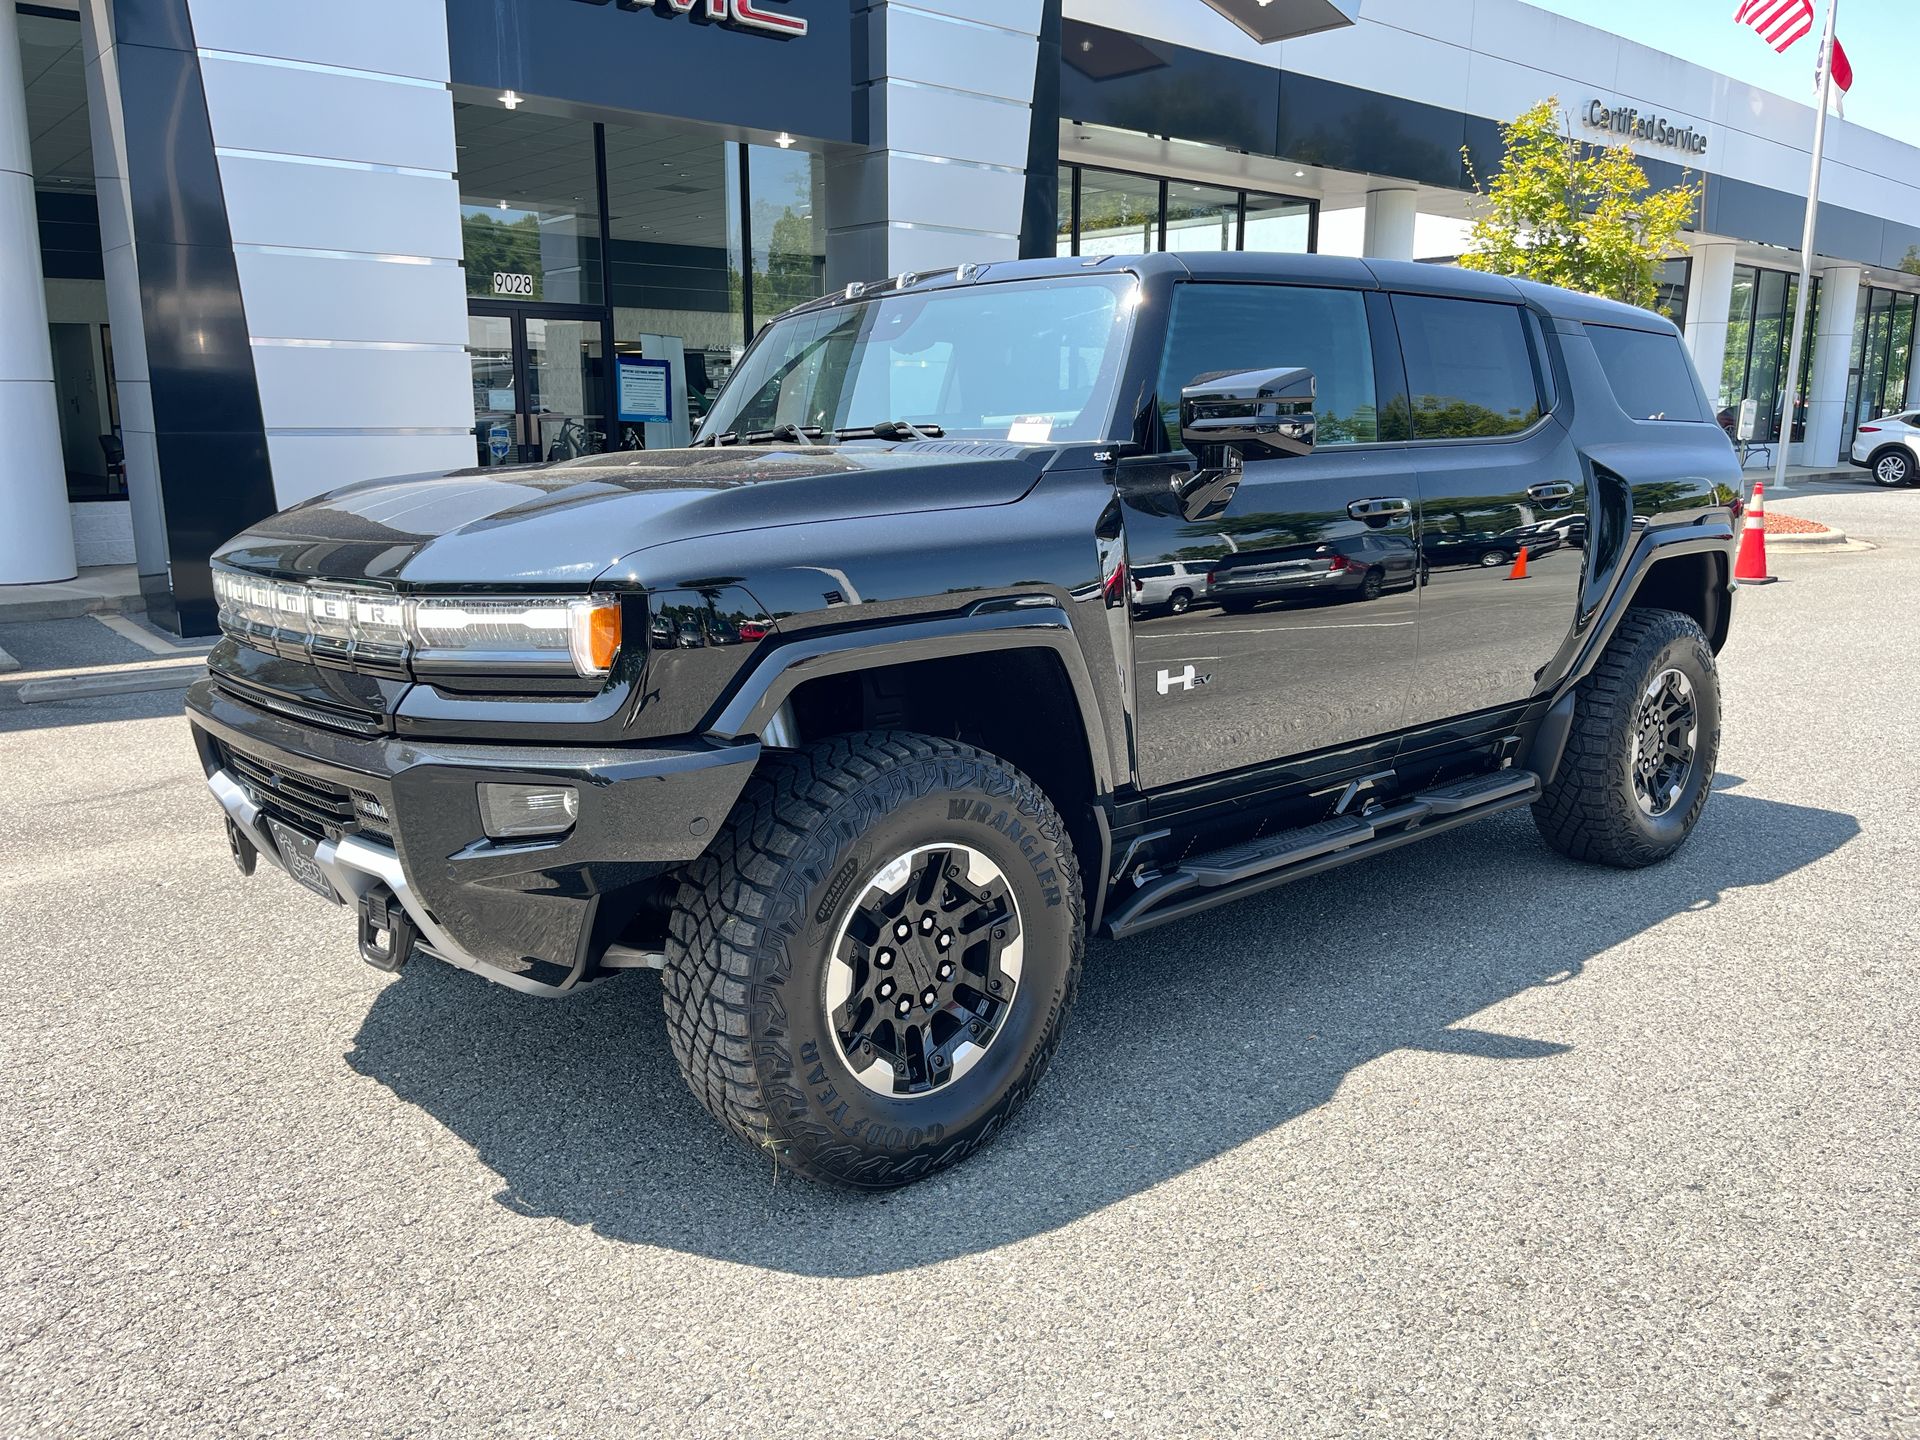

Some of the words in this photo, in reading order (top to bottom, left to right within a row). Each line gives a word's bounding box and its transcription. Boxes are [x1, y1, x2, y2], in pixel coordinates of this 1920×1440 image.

[1657, 118, 1707, 154] Service
[495, 274, 532, 294] 9028
[231, 585, 386, 623] UMMER
[946, 798, 1063, 908] WRANGLER
[818, 861, 855, 919] DURAWALL
[799, 1037, 945, 1151] GOODYEAR
